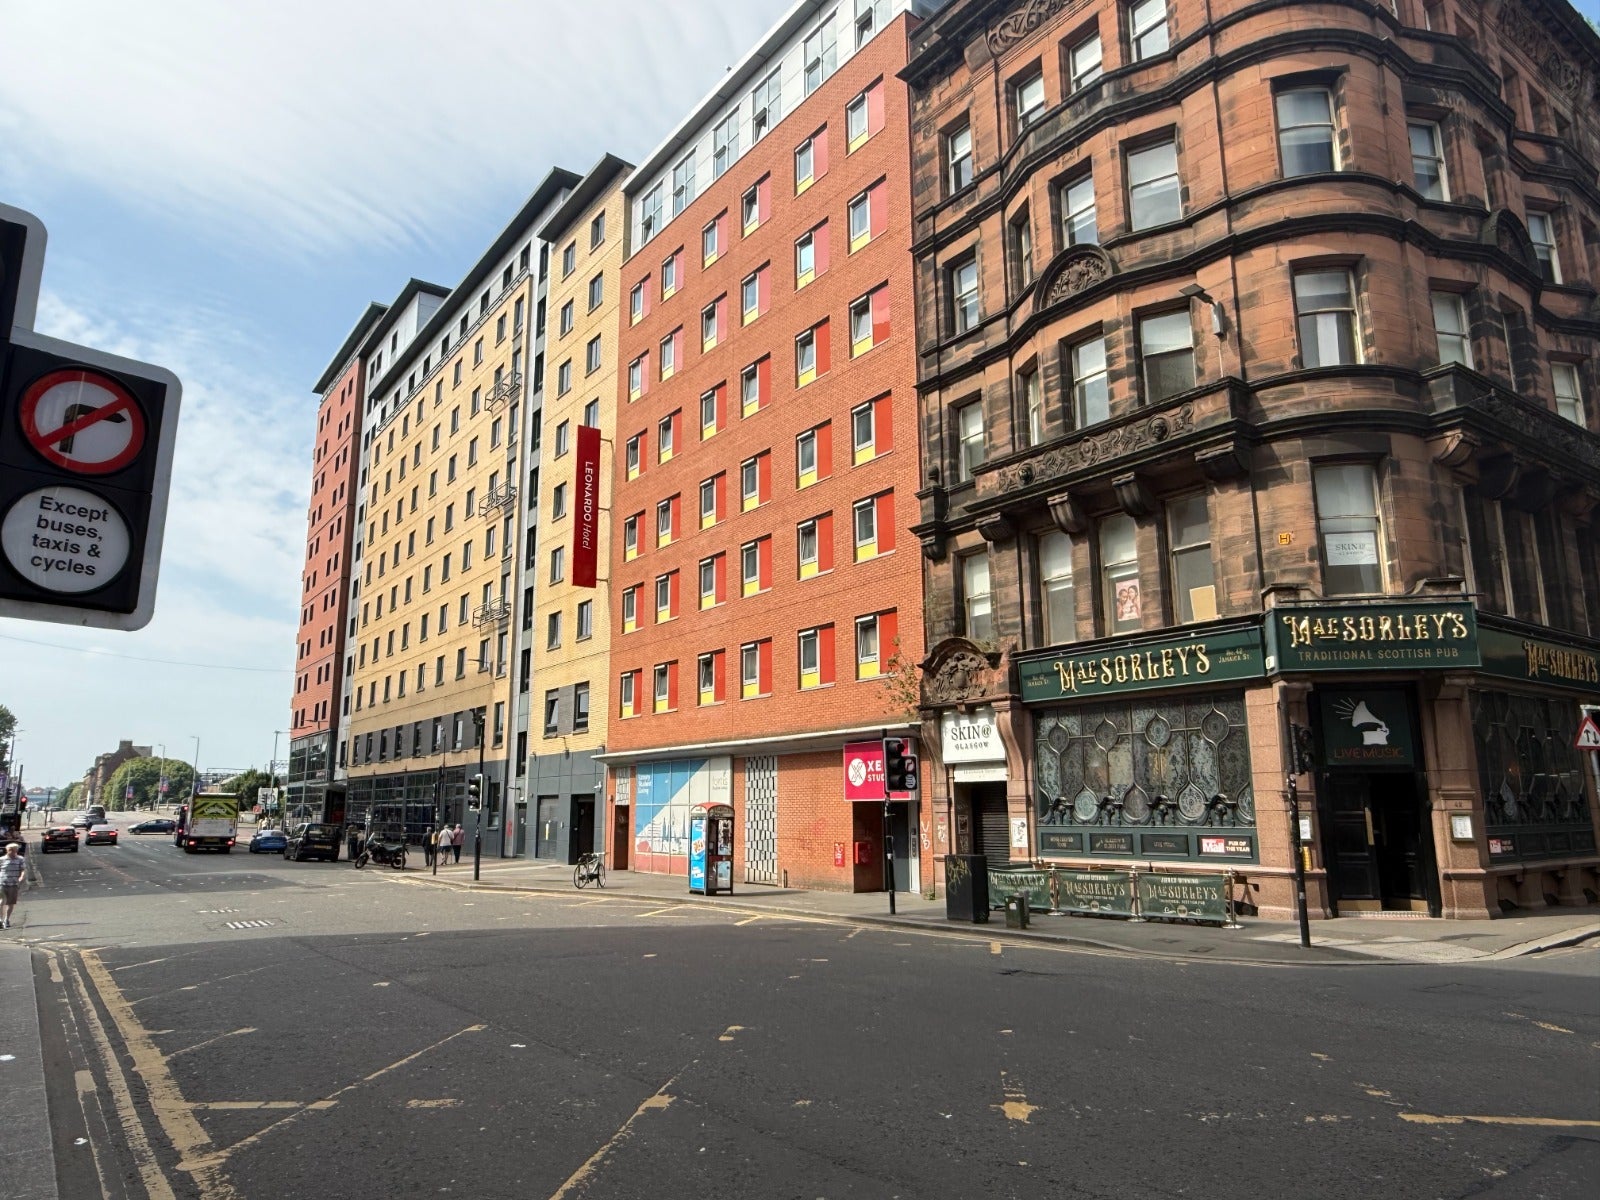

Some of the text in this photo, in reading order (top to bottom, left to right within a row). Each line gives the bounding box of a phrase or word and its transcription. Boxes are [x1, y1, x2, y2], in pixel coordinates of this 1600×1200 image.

[39, 495, 109, 523] Except
[582, 461, 594, 550] LEONARDO Hotel
[36, 515, 103, 542] buses,
[31, 533, 102, 559] taxis &
[30, 554, 97, 577] cycles
[1298, 647, 1459, 661] TRADITIONAL SCOTTISH PUB
[951, 724, 991, 741] SKIN@
[955, 741, 989, 750] GLASGOW
[1334, 746, 1405, 759] LIVE MUSIC
